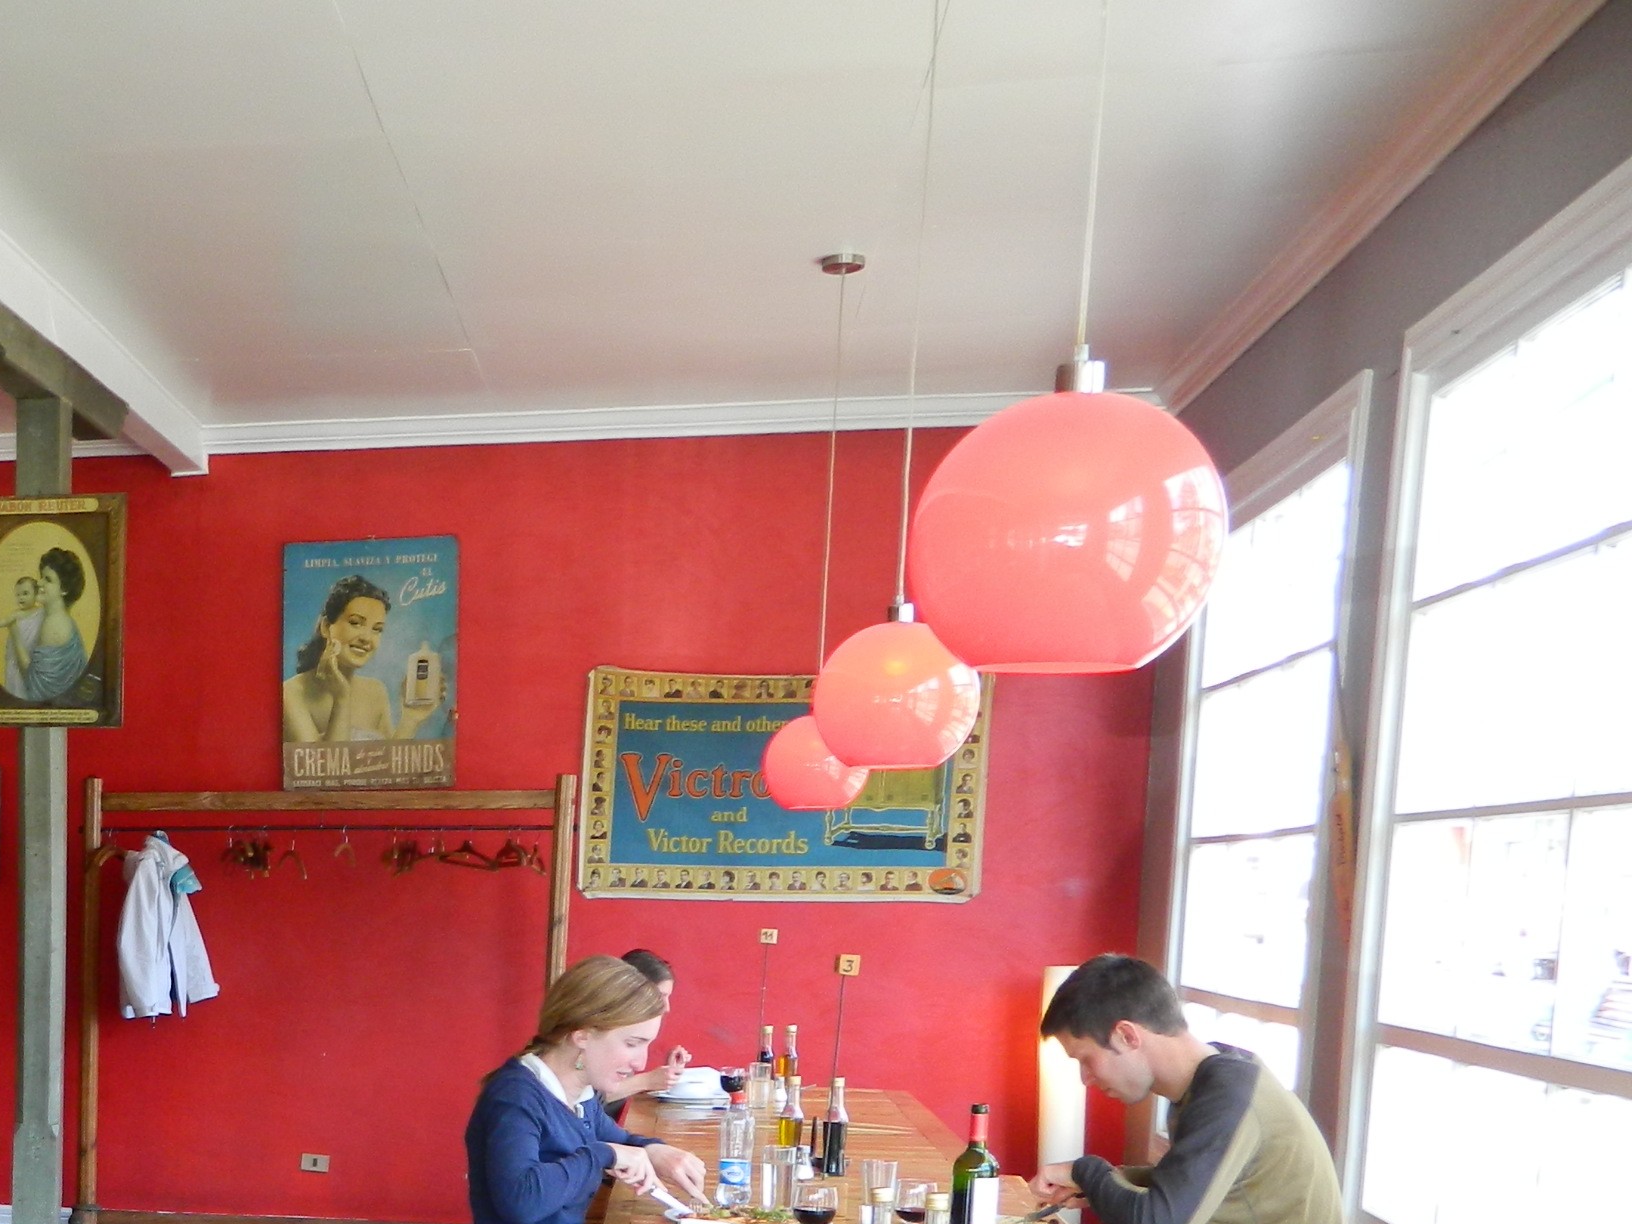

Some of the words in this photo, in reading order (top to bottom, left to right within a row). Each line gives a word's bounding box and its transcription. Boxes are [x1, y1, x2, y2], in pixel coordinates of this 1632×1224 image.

[400, 576, 447, 606] Cutis
[624, 713, 663, 732] Hear
[666, 715, 707, 732] these
[711, 716, 742, 732] and
[293, 747, 351, 777] CREMA
[391, 743, 445, 774] HINDS
[620, 751, 771, 824] Victro
[710, 807, 748, 823] and
[647, 828, 713, 853] Victor
[718, 829, 809, 855] Records
[842, 959, 855, 973] 3
